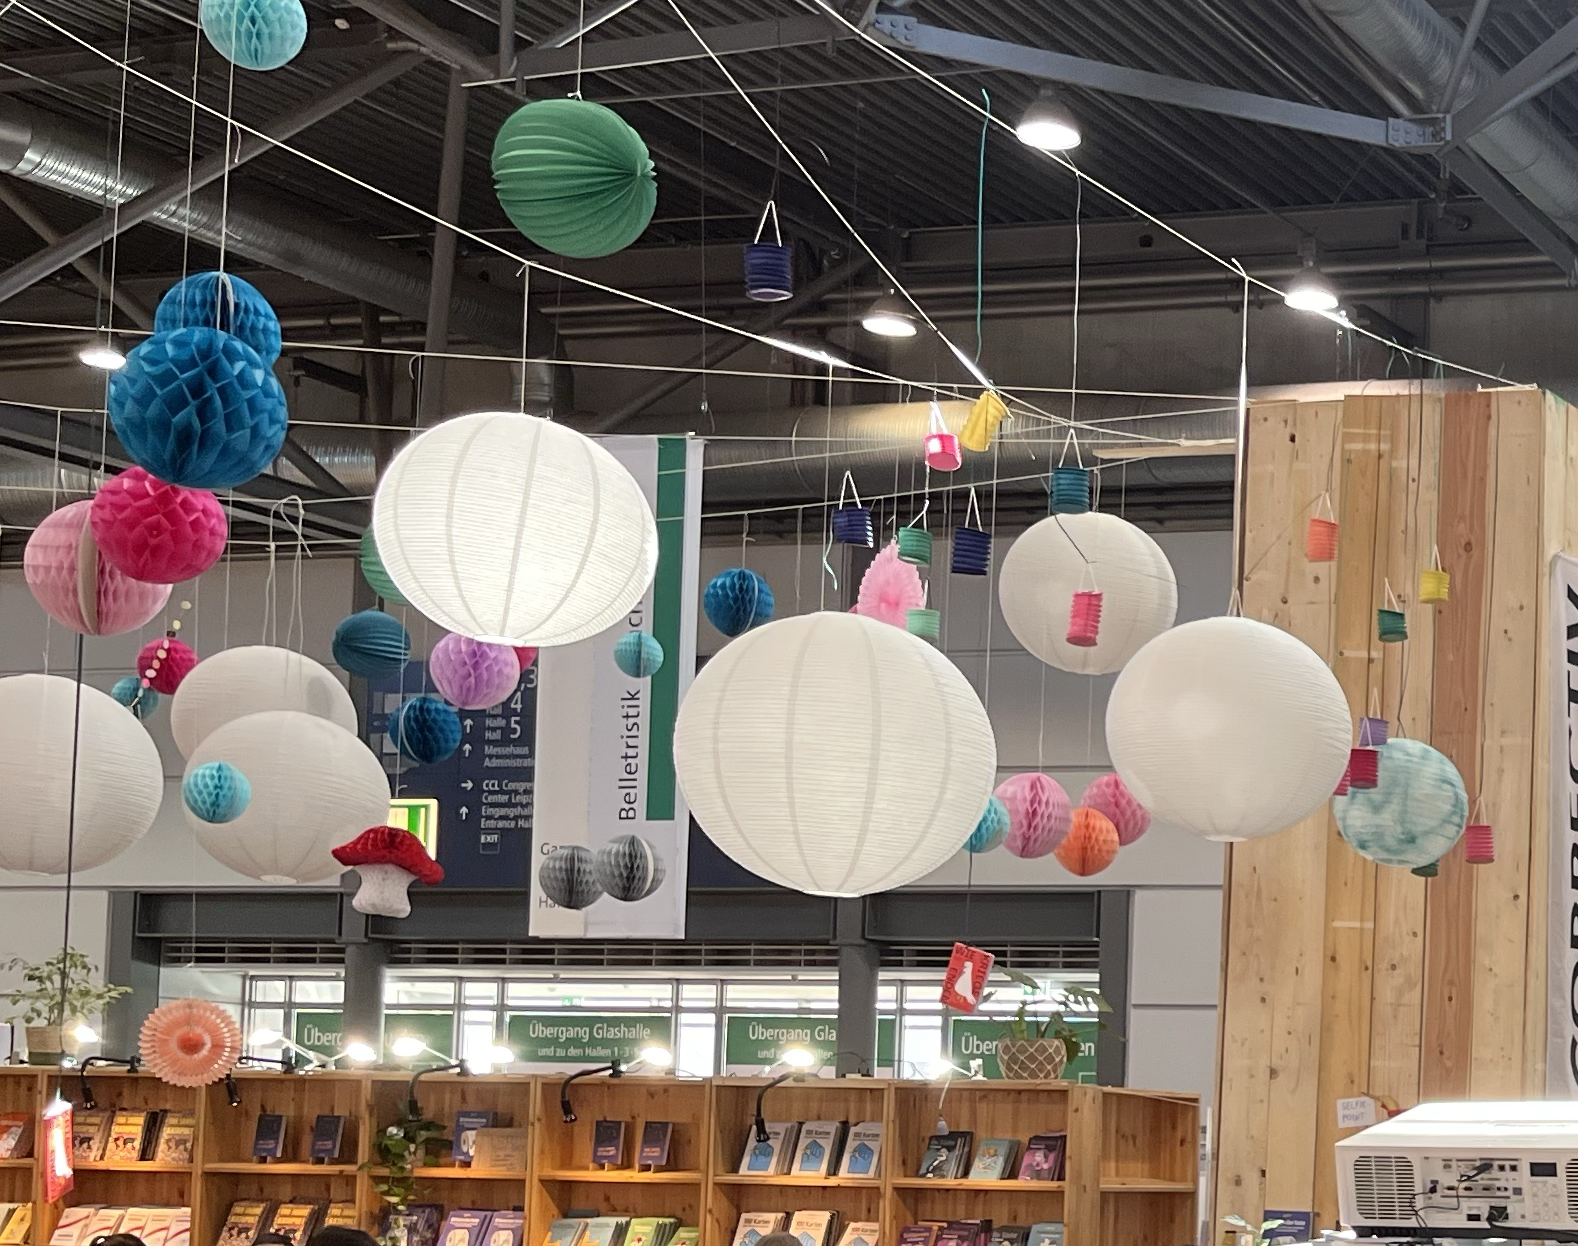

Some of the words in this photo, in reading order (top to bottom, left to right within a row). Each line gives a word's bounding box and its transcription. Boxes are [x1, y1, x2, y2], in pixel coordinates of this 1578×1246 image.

[510, 716, 521, 739] 5
[618, 688, 641, 821] Belletristik
[529, 1020, 590, 1043] Übergang
[593, 1022, 651, 1041] Glashalle
[748, 1022, 811, 1045] Übergang
[537, 1046, 553, 1057] und
[554, 1047, 566, 1057] zu
[568, 1046, 583, 1057] den
[585, 1046, 611, 1057] Hallen
[961, 1032, 997, 1055] Über
